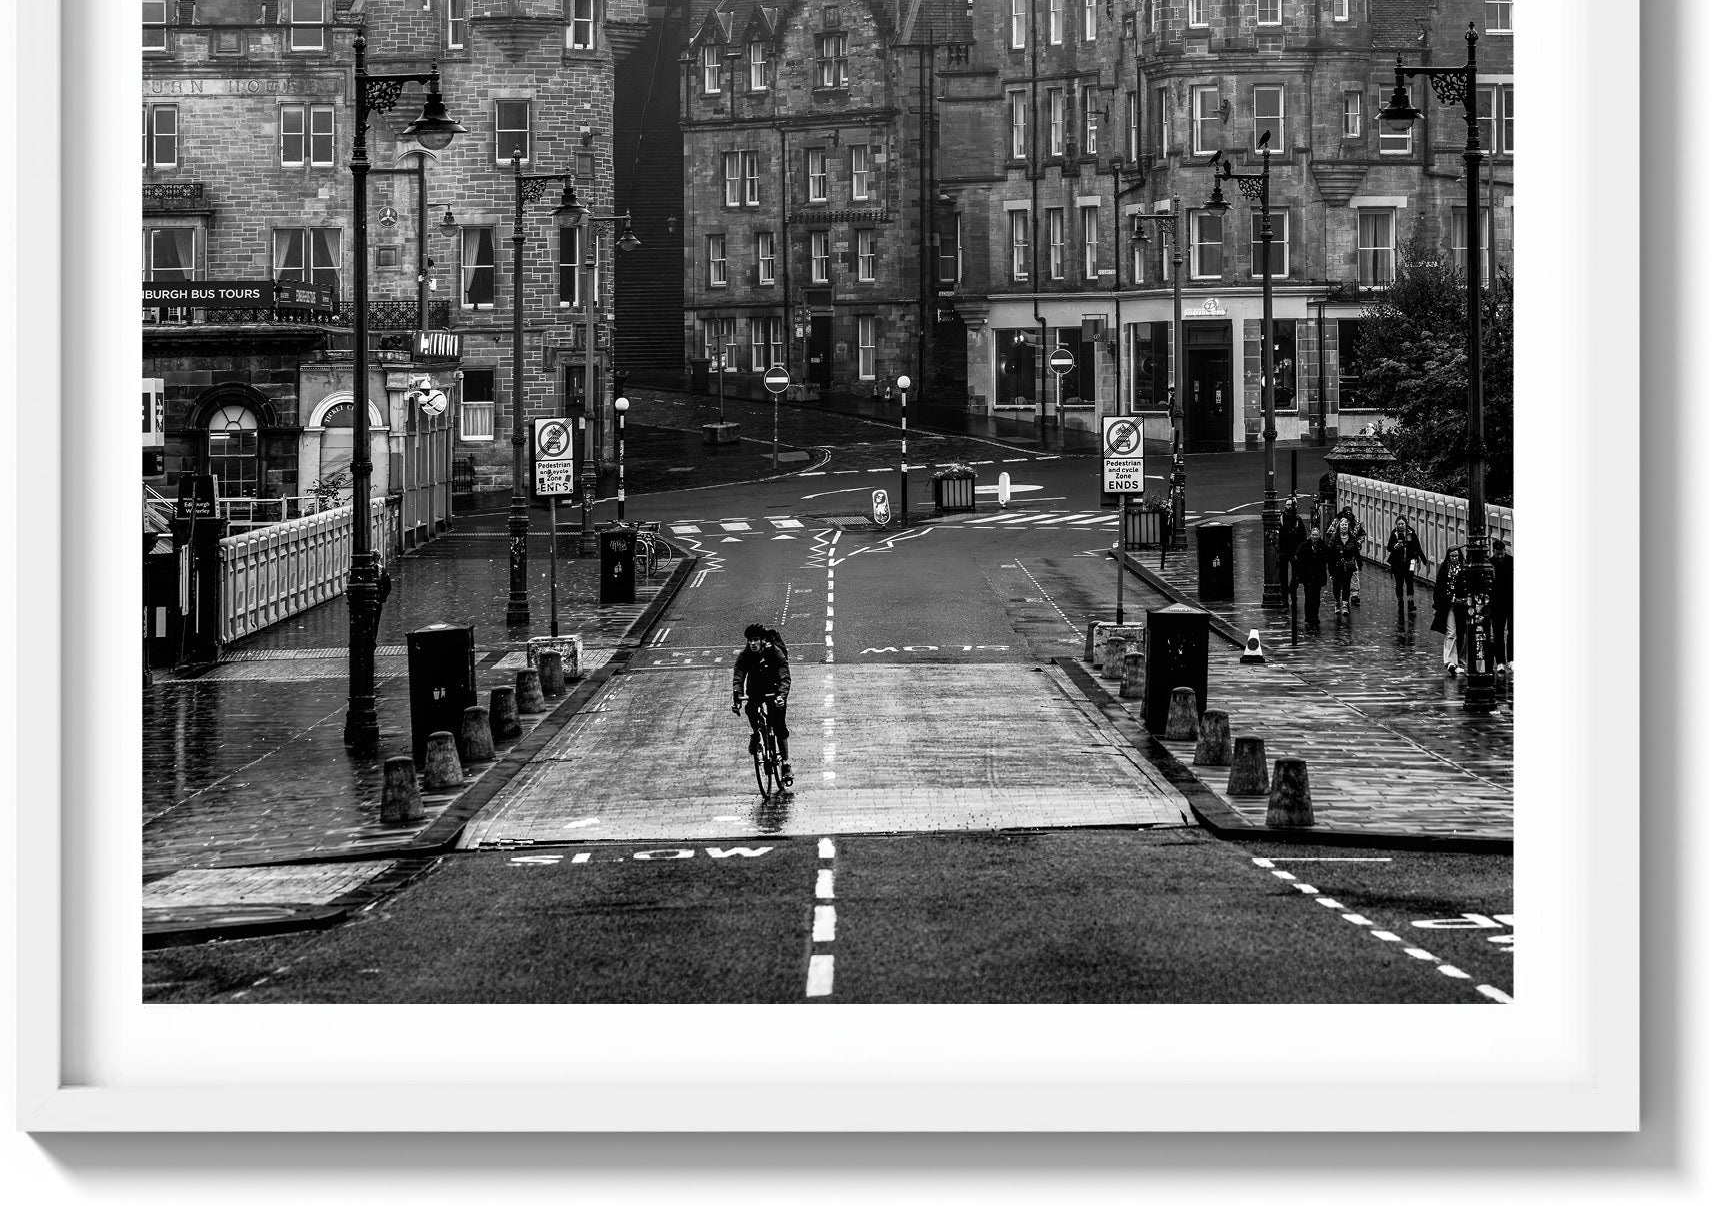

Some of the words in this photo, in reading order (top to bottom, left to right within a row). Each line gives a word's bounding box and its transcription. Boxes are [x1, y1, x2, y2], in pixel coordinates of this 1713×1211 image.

[191, 290, 216, 299] BUS
[219, 290, 261, 299] TOURS
[324, 405, 344, 423] TICKET
[1109, 481, 1138, 489] ENDS
[506, 846, 774, 866] SLOW
